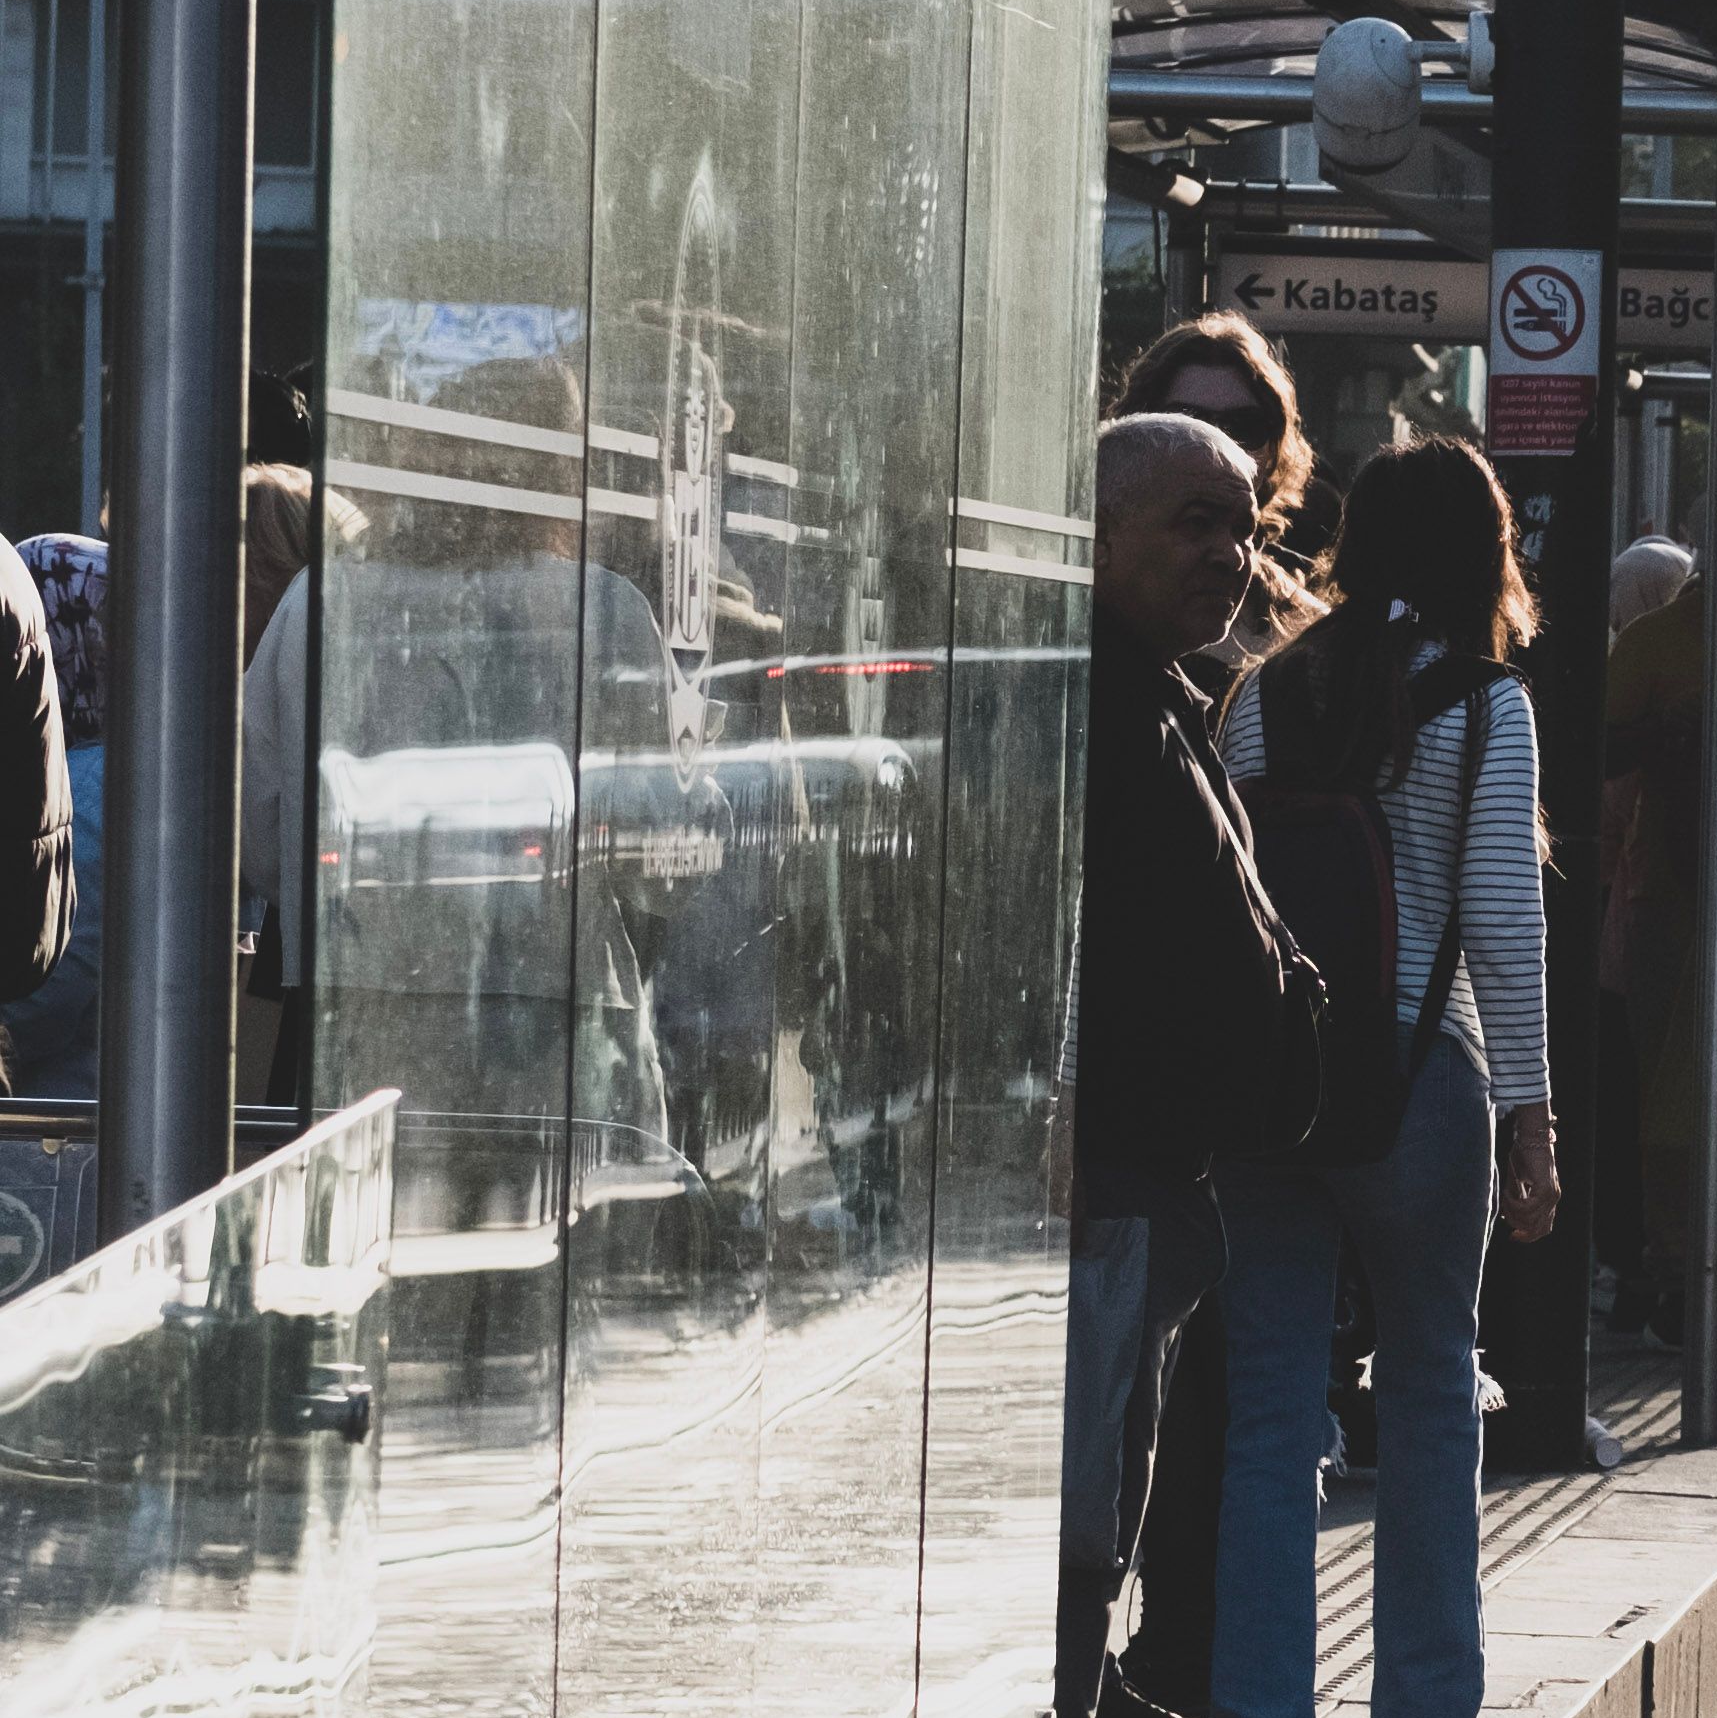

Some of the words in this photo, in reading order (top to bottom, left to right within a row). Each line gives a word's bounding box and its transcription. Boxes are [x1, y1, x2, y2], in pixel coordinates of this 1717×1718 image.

[1284, 278, 1438, 323] Kabataş
[1549, 379, 1581, 388] kanun
[1540, 393, 1581, 403] istasyon
